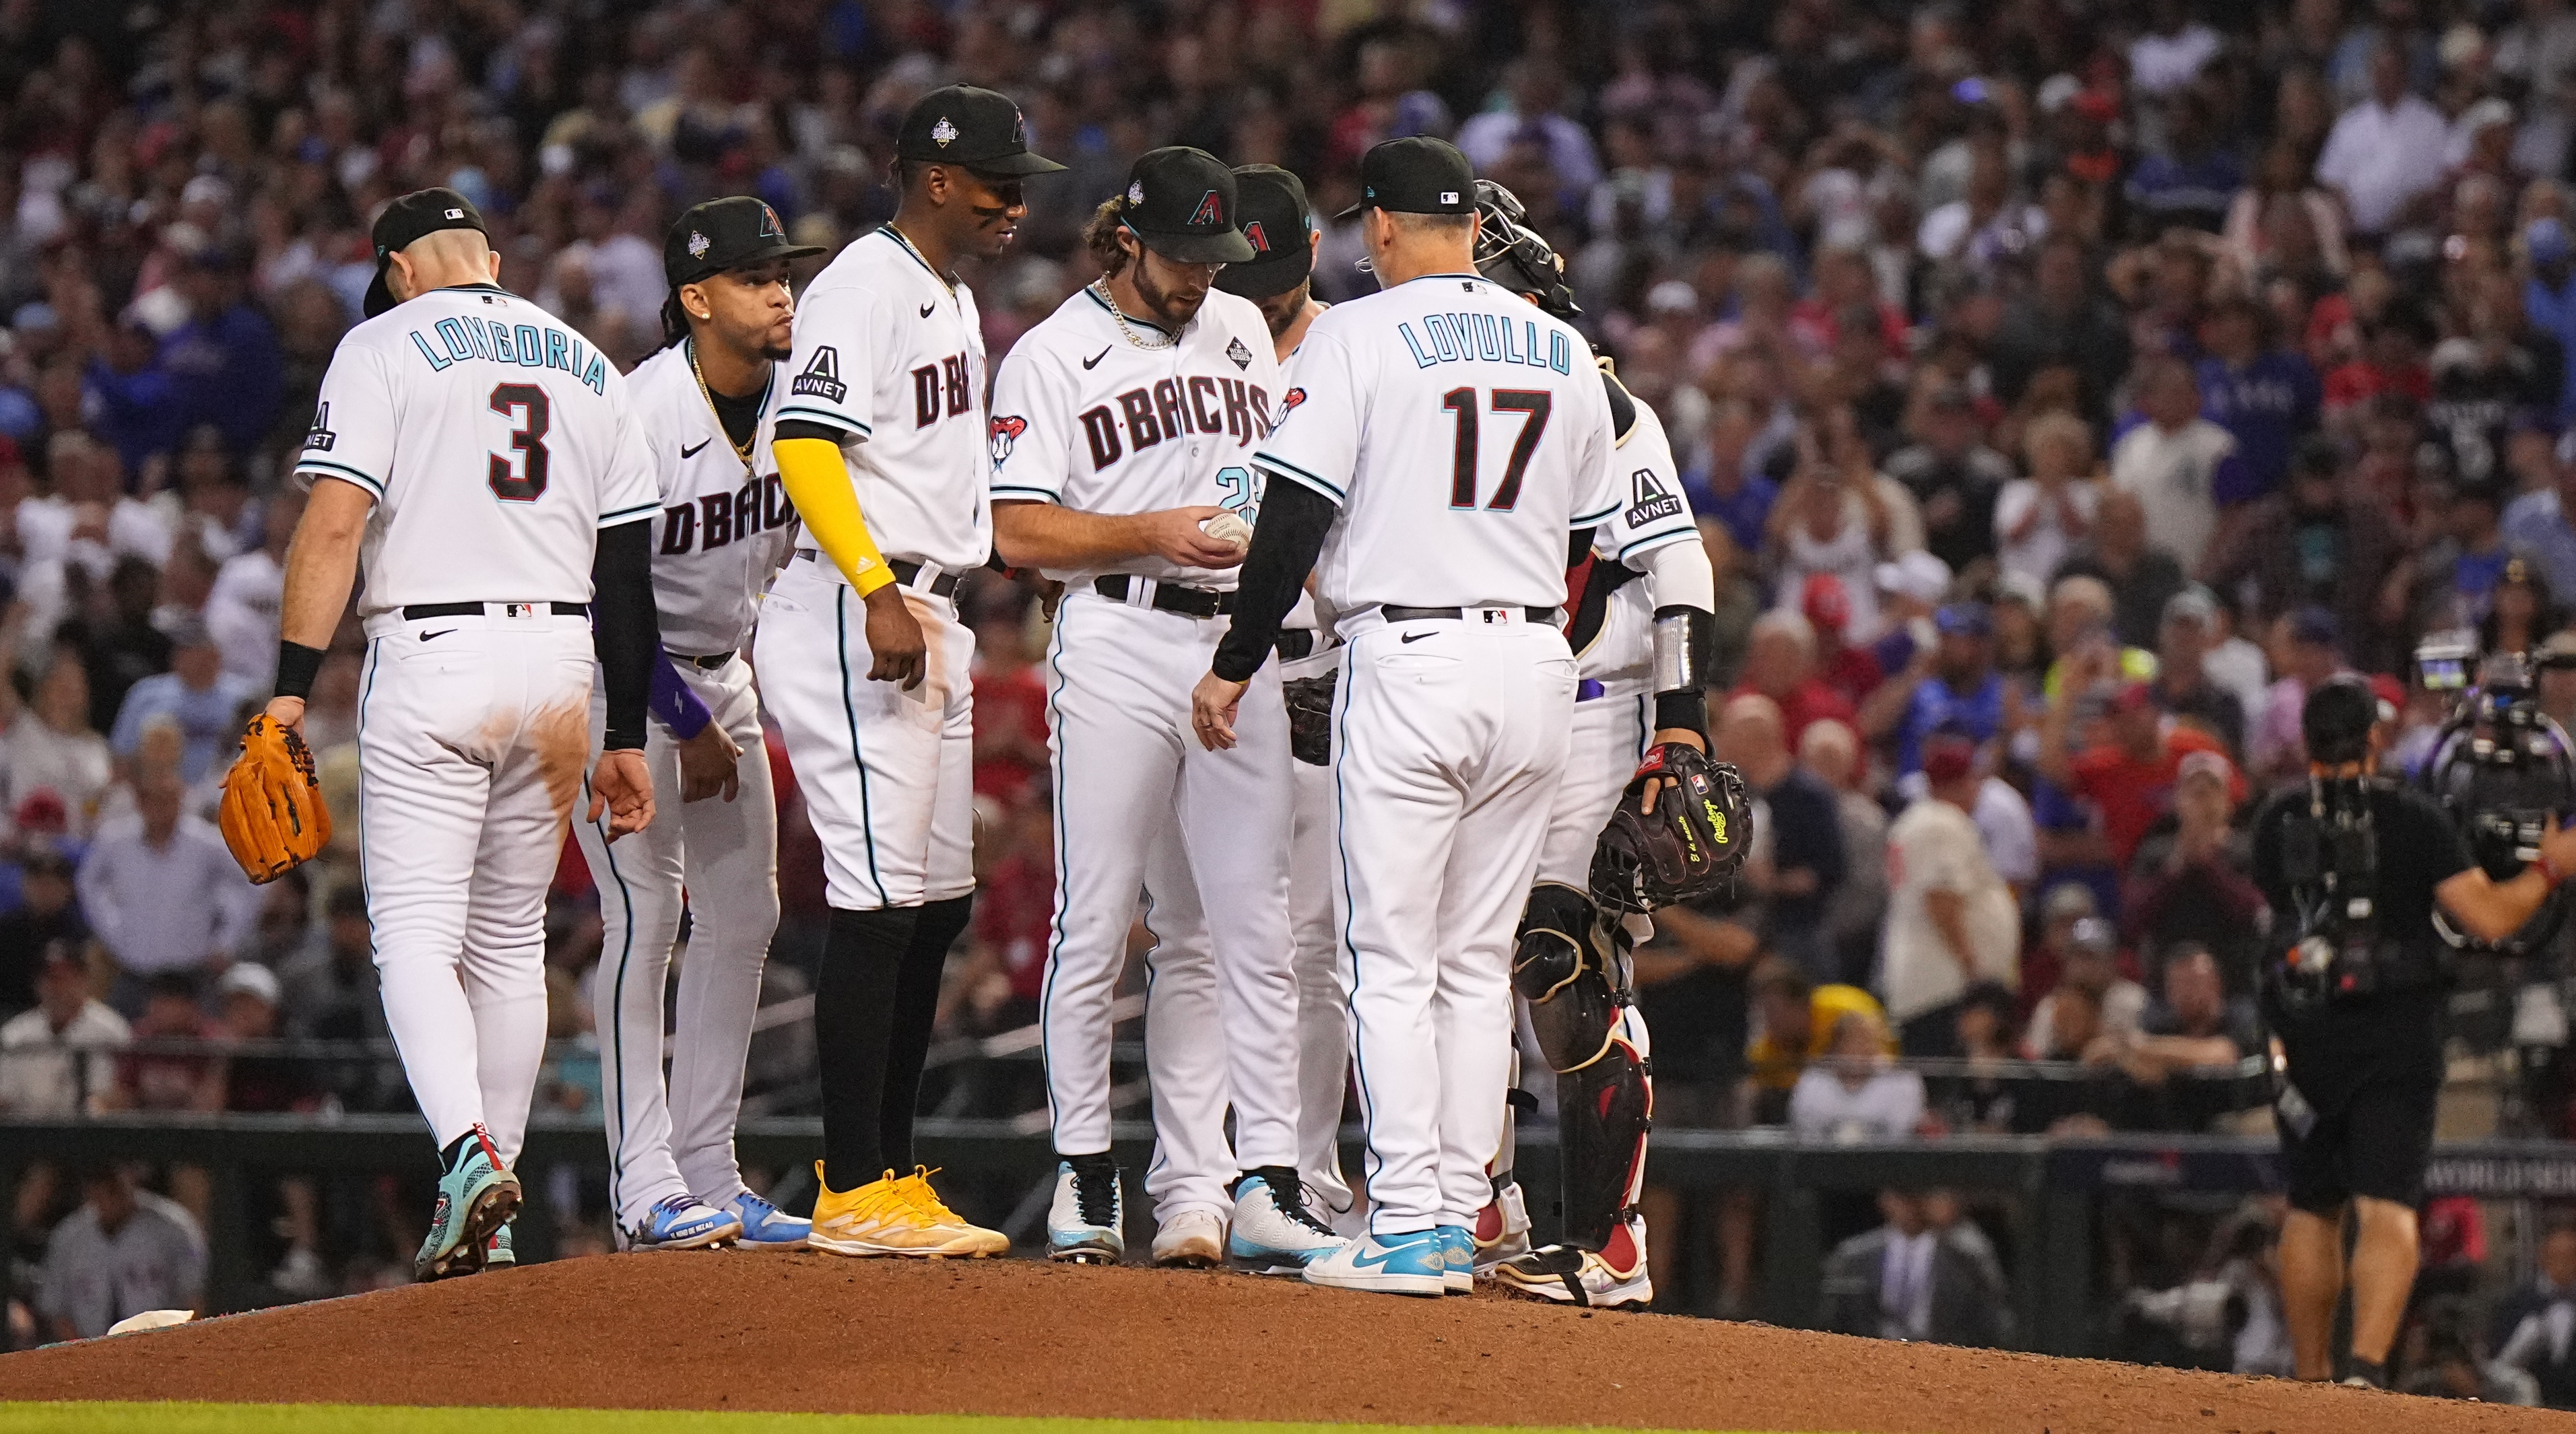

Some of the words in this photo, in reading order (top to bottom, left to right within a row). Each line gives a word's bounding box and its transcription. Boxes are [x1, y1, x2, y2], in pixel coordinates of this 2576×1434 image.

[1187, 190, 1223, 225] A
[409, 316, 605, 396] LONGORIA
[1228, 347, 1249, 355] WORLD
[1230, 353, 1251, 362] SERIES
[1398, 313, 1570, 376] LOVULLO
[793, 378, 845, 399] AVNET
[304, 433, 333, 448] NET
[486, 381, 551, 504] 3
[1441, 385, 1554, 514] 17
[1216, 466, 1263, 527] 2
[1632, 497, 1679, 525] AVNET
[1678, 815, 1693, 841] macuto
[1704, 798, 1728, 844] Rawlings
[1688, 842, 1696, 852] de
